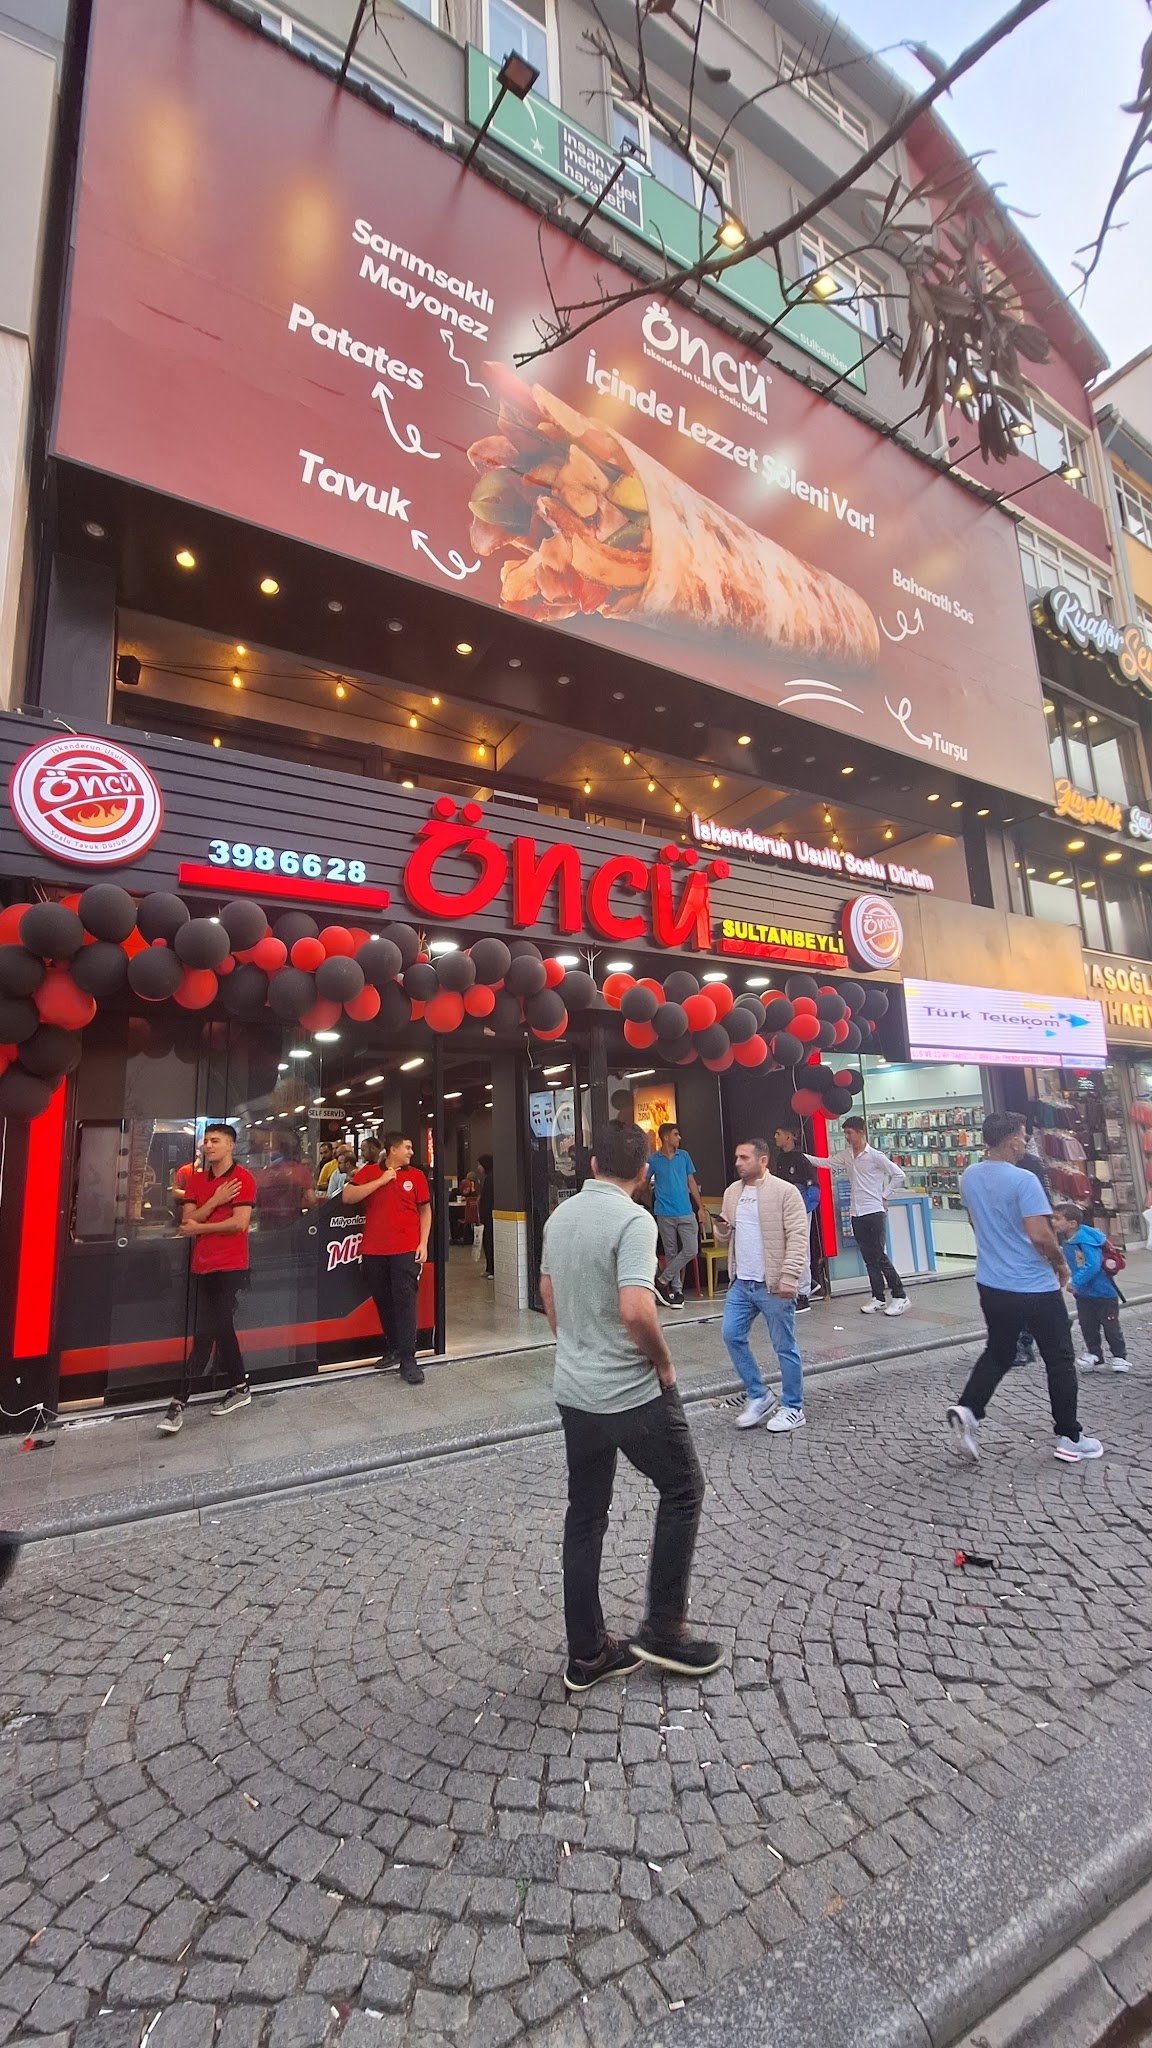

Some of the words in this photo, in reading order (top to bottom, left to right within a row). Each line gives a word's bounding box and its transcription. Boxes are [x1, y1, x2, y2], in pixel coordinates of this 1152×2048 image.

[352, 218, 494, 315] Sarımsaklı
[359, 254, 489, 342] Mayonez
[288, 302, 424, 390] Patates
[585, 348, 674, 427] İçinde
[677, 405, 759, 474] Lezzet
[761, 453, 829, 513] Şöleni
[831, 491, 875, 538] Var!
[299, 449, 412, 522] Tavuk
[892, 568, 952, 614] Baharatlı
[952, 600, 974, 625] Sos
[1053, 591, 1125, 650] Kuaför
[932, 731, 968, 761] Turşu
[74, 841, 99, 850] Tavuk
[794, 840, 843, 871] Usulü
[843, 852, 886, 880] Soslu
[887, 863, 934, 891] Dürüm
[722, 919, 845, 954] SULTANBEYLİ
[923, 1006, 971, 1020] Türk
[979, 1011, 1060, 1028] Telekom
[308, 1109, 323, 1117] SELF
[323, 1109, 345, 1117] SERVİS
